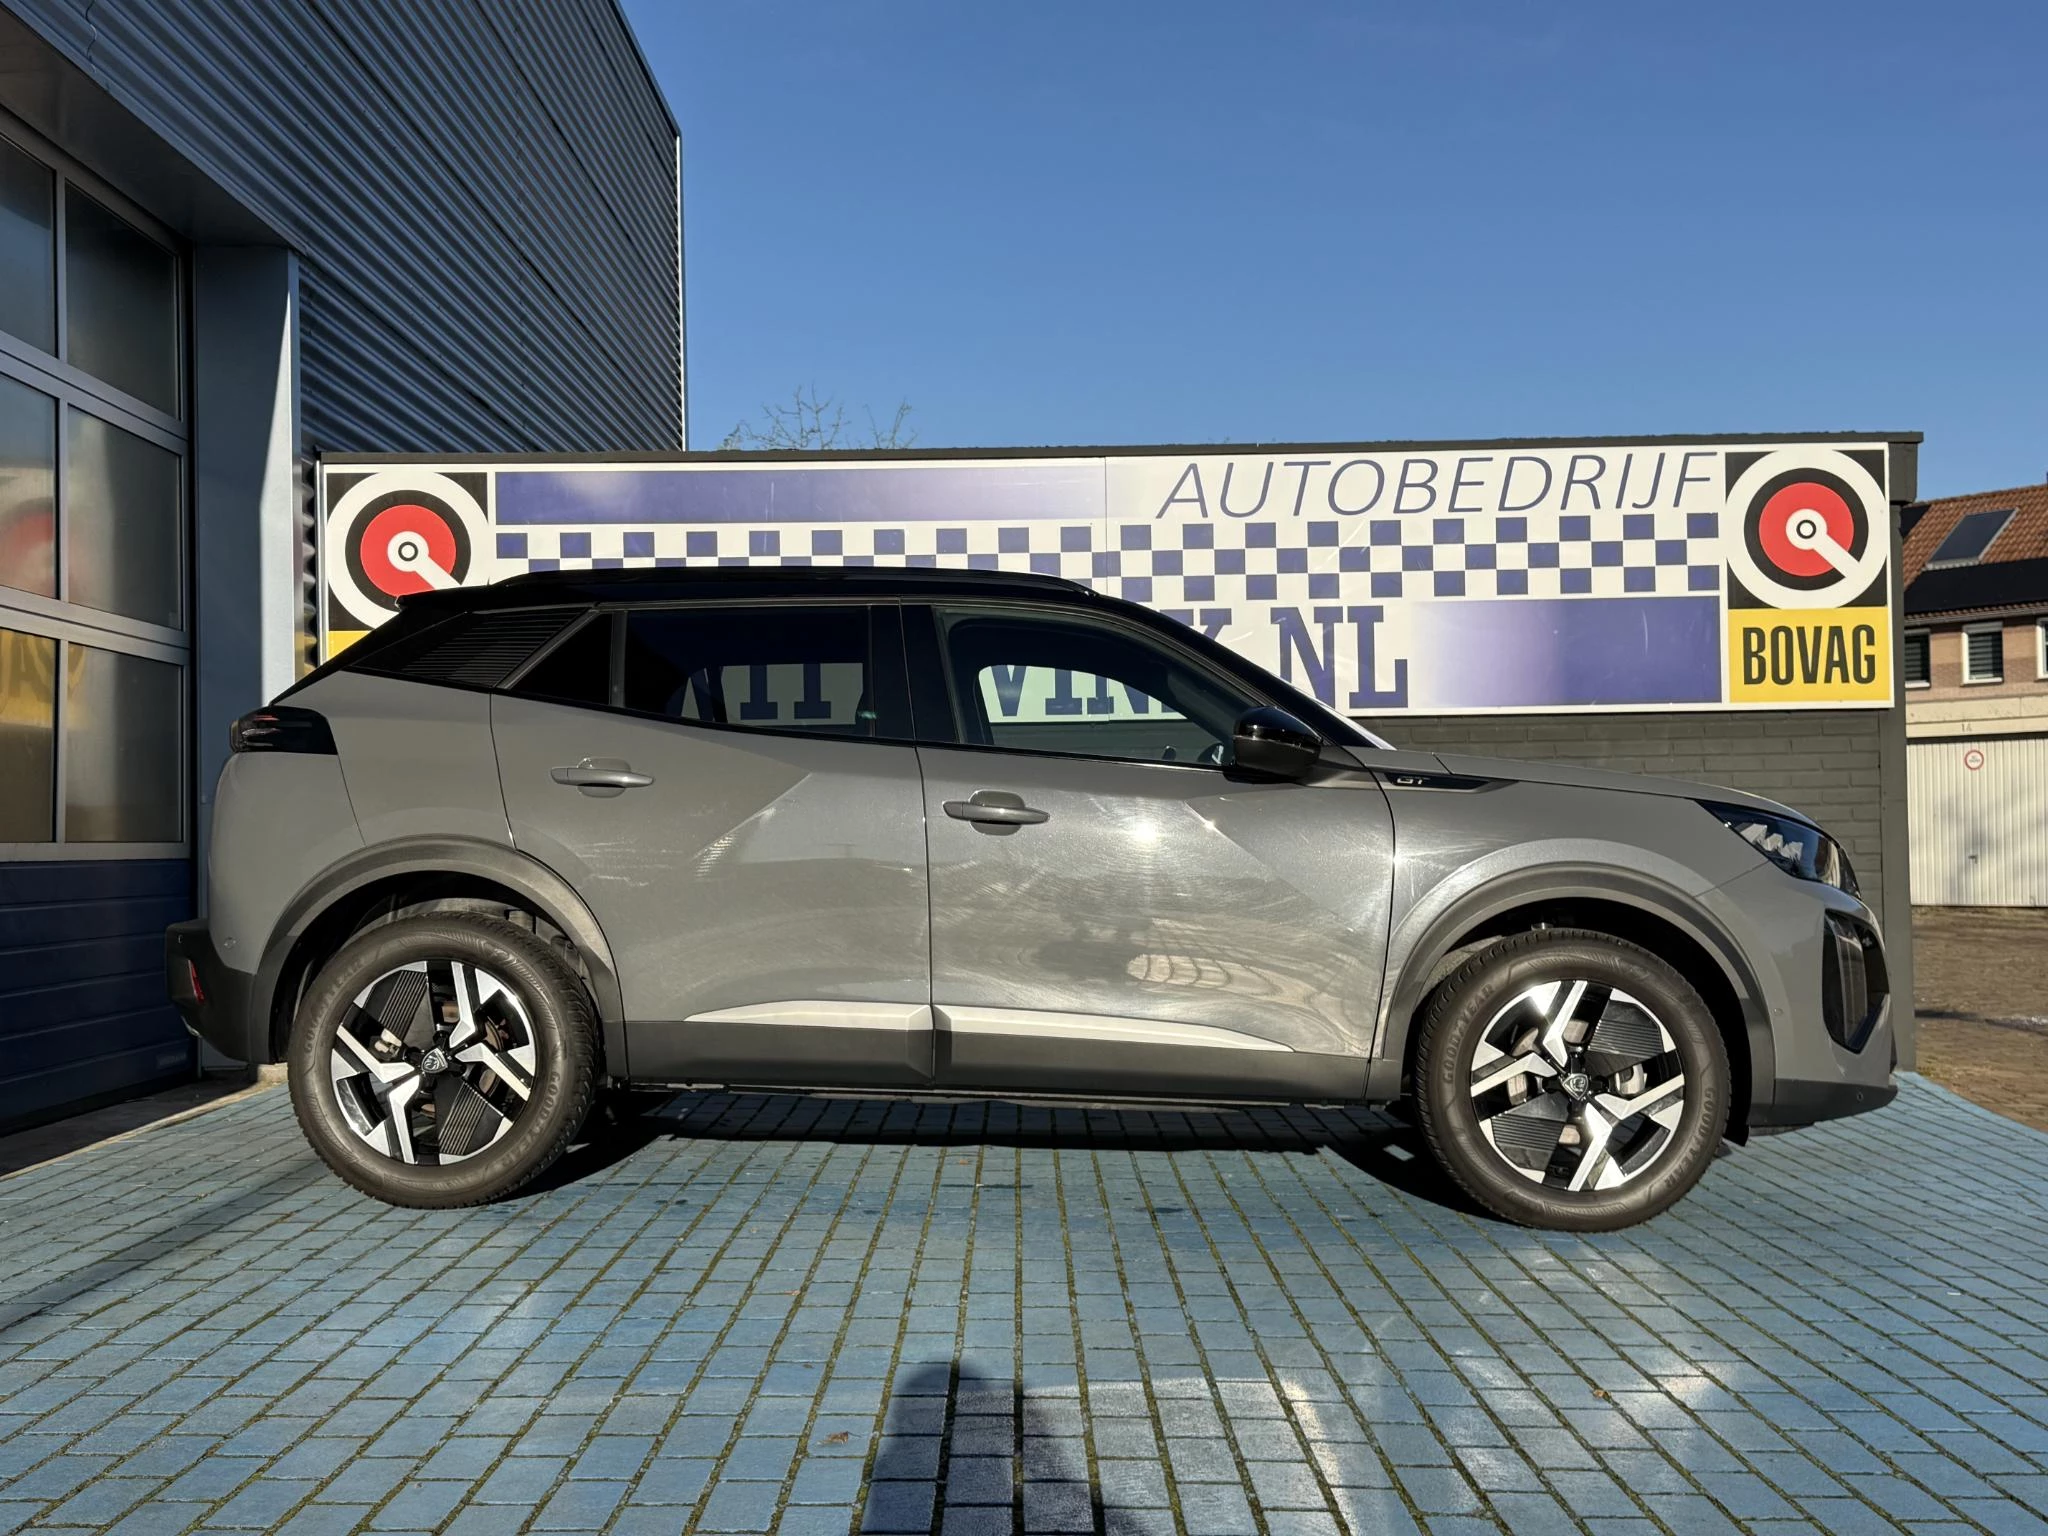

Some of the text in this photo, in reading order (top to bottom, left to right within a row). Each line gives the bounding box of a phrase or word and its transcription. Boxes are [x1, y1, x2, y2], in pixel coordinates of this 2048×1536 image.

[1156, 452, 1718, 519] AUTOBEDRIJF
[1742, 624, 1876, 685] BOVAG
[1442, 983, 1496, 1083] GOODYEAR
[1664, 1087, 1716, 1188] GOODYEAR
